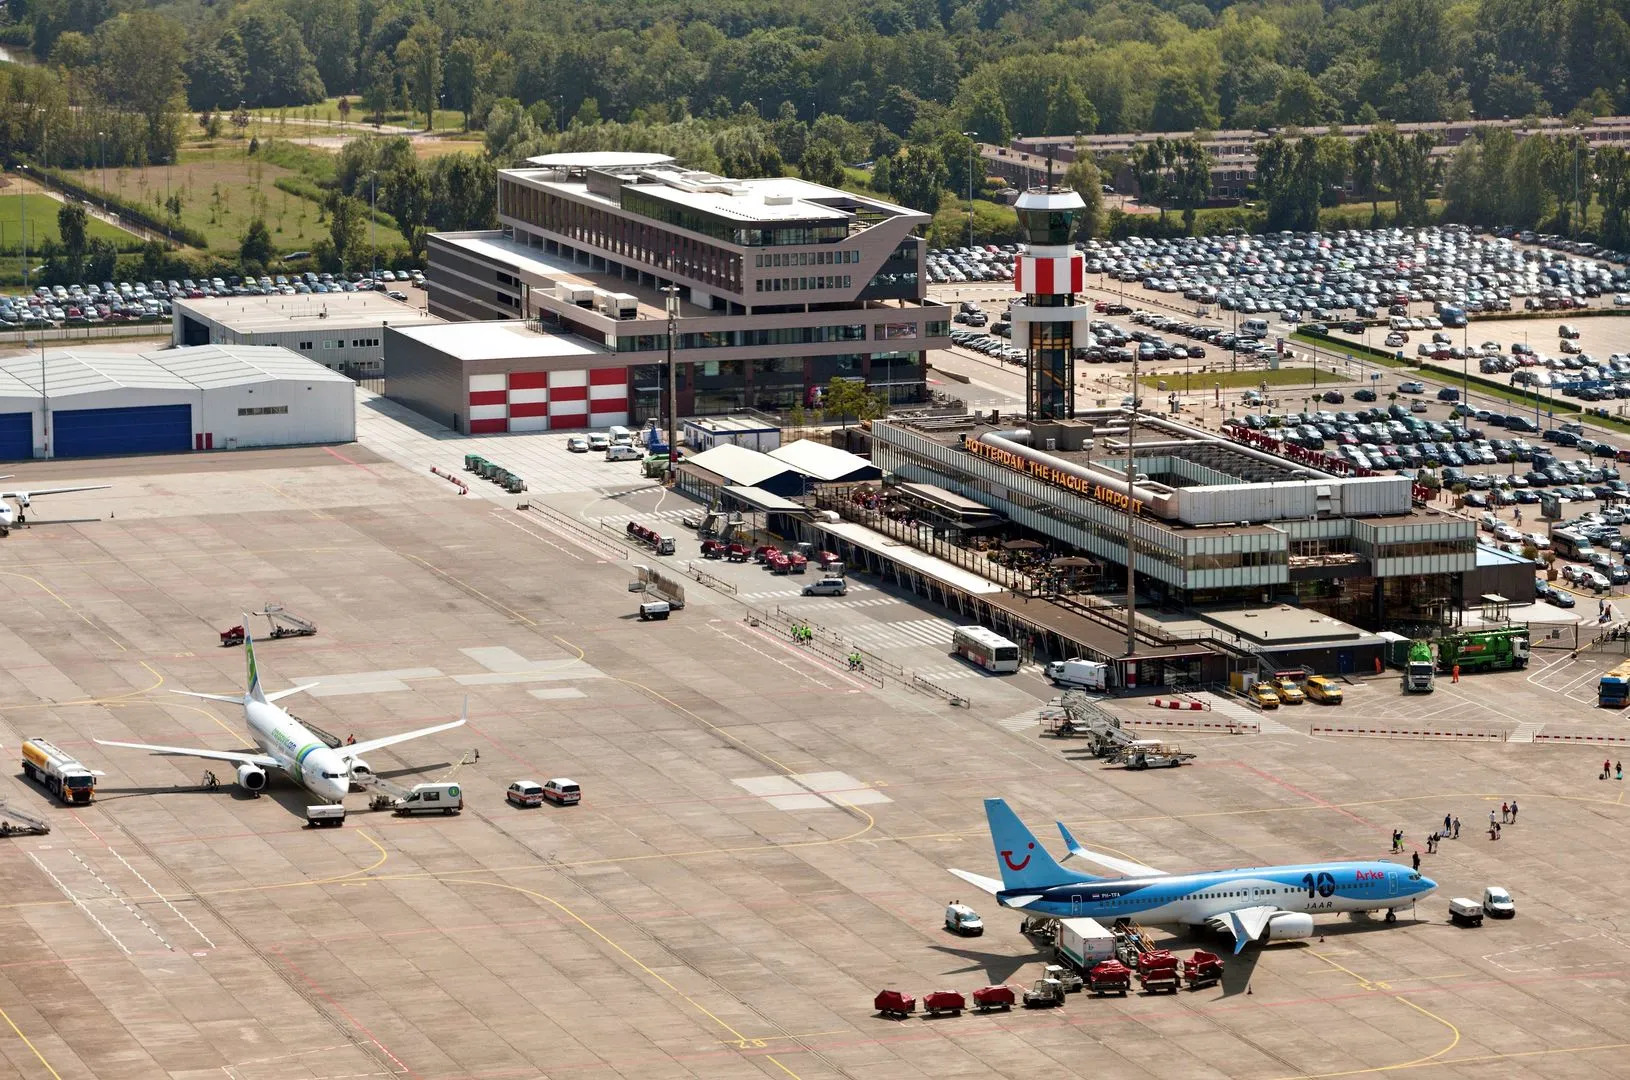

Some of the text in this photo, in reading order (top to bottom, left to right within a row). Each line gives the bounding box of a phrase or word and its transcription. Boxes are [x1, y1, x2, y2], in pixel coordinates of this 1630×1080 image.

[965, 438, 1025, 470] ROTTERDAM
[1029, 461, 1049, 479] THE
[1051, 469, 1089, 494] HAGUE
[1356, 869, 1385, 881] Arke
[1302, 872, 1336, 899] 10
[1304, 901, 1333, 910] JAAR
